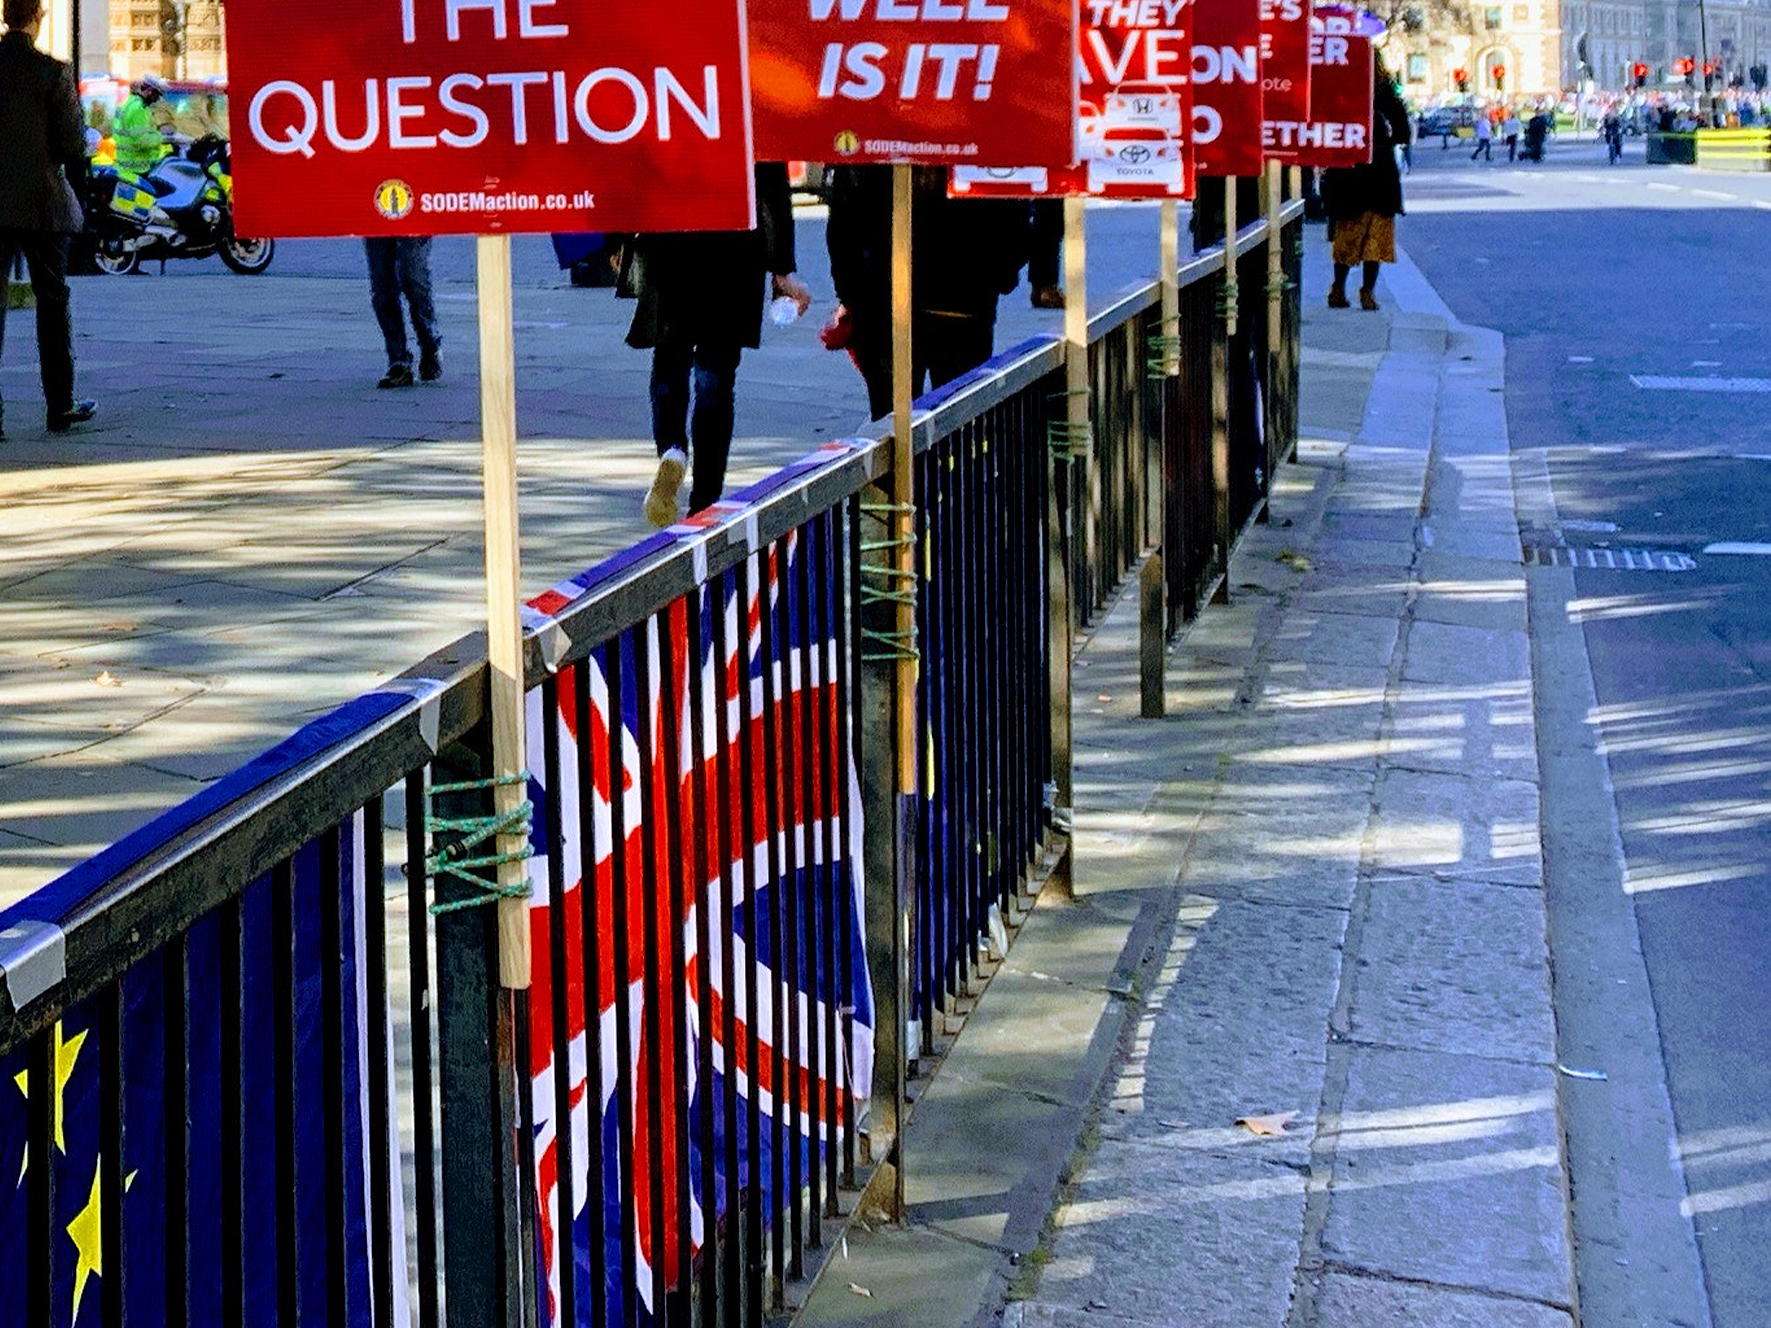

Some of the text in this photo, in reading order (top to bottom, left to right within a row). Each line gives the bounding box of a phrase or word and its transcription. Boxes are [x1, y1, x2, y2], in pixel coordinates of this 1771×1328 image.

[817, 42, 1000, 100] IS IT!
[249, 65, 720, 159] QUESTION
[864, 139, 979, 156] SODEMaction.co.uk
[420, 190, 595, 212] SODEMaction.co.uk
